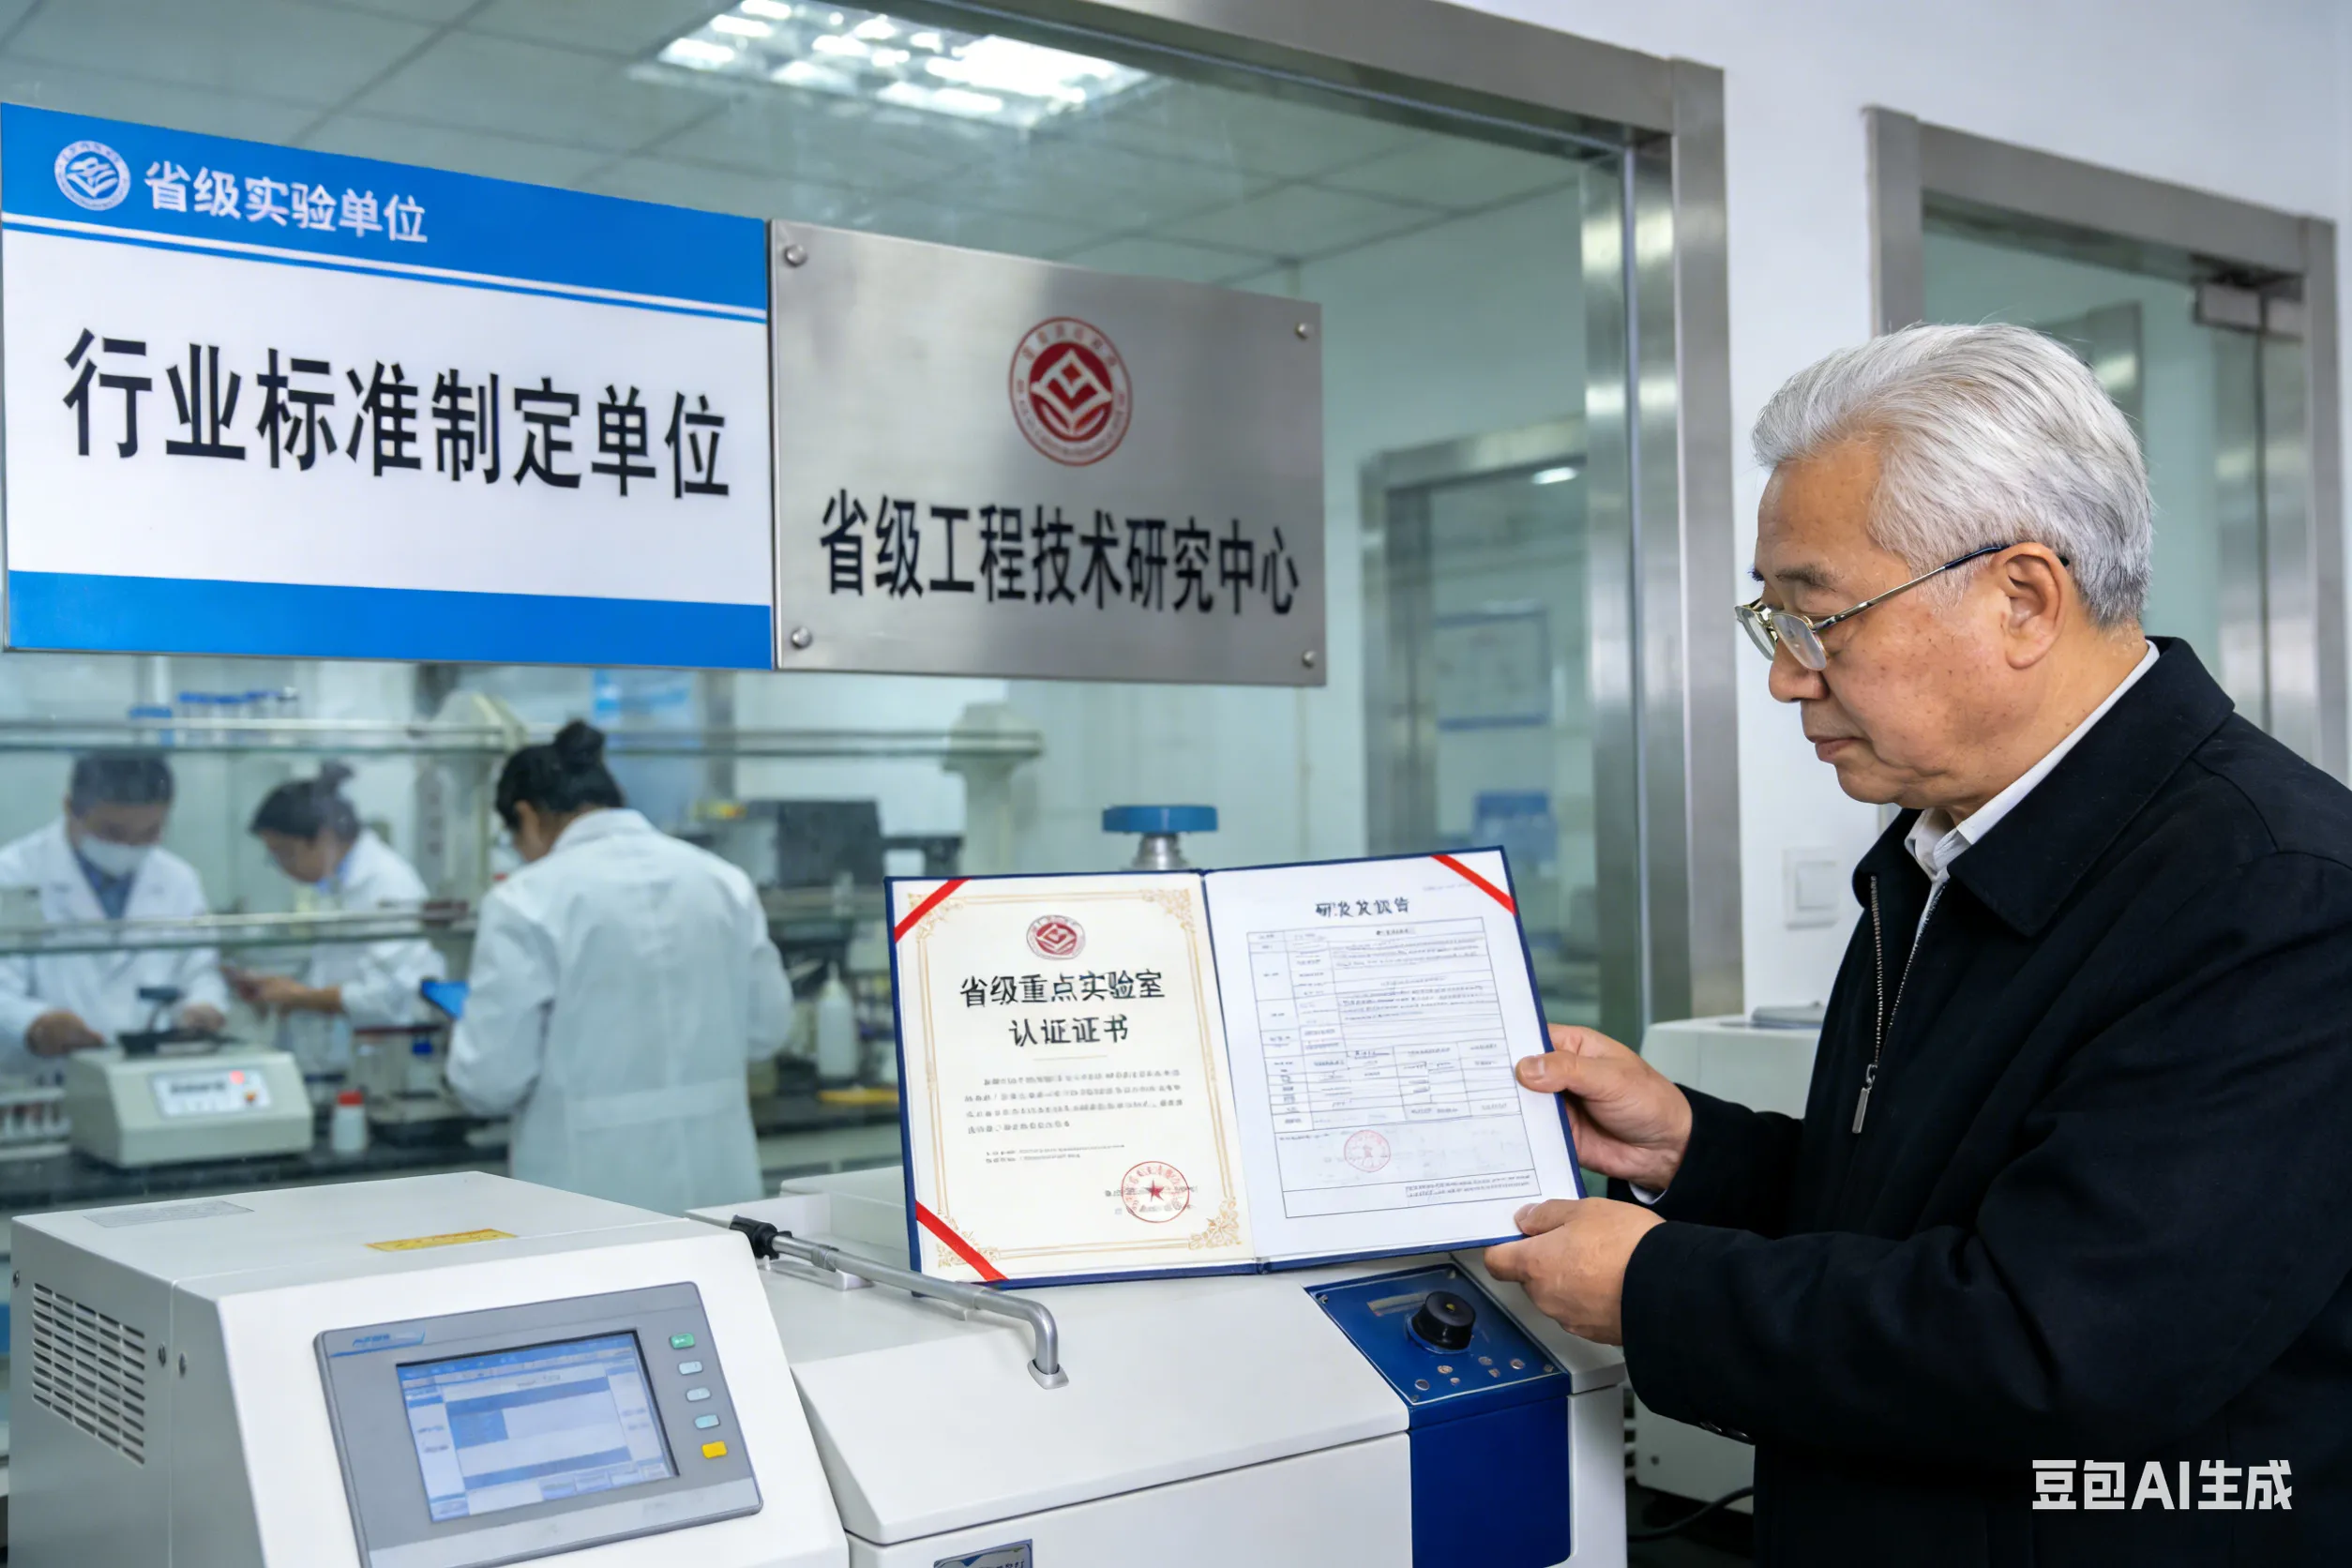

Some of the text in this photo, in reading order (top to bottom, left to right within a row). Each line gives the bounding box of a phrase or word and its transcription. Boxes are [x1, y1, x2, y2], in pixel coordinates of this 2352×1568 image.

[144, 160, 428, 243] 省级实验单位
[63, 326, 731, 500] 行业标准制定单位
[820, 489, 1301, 615] 省级工程技术研究中心
[960, 969, 1165, 1008] 省级重点实验室
[1008, 1014, 1128, 1047] 认证证书
